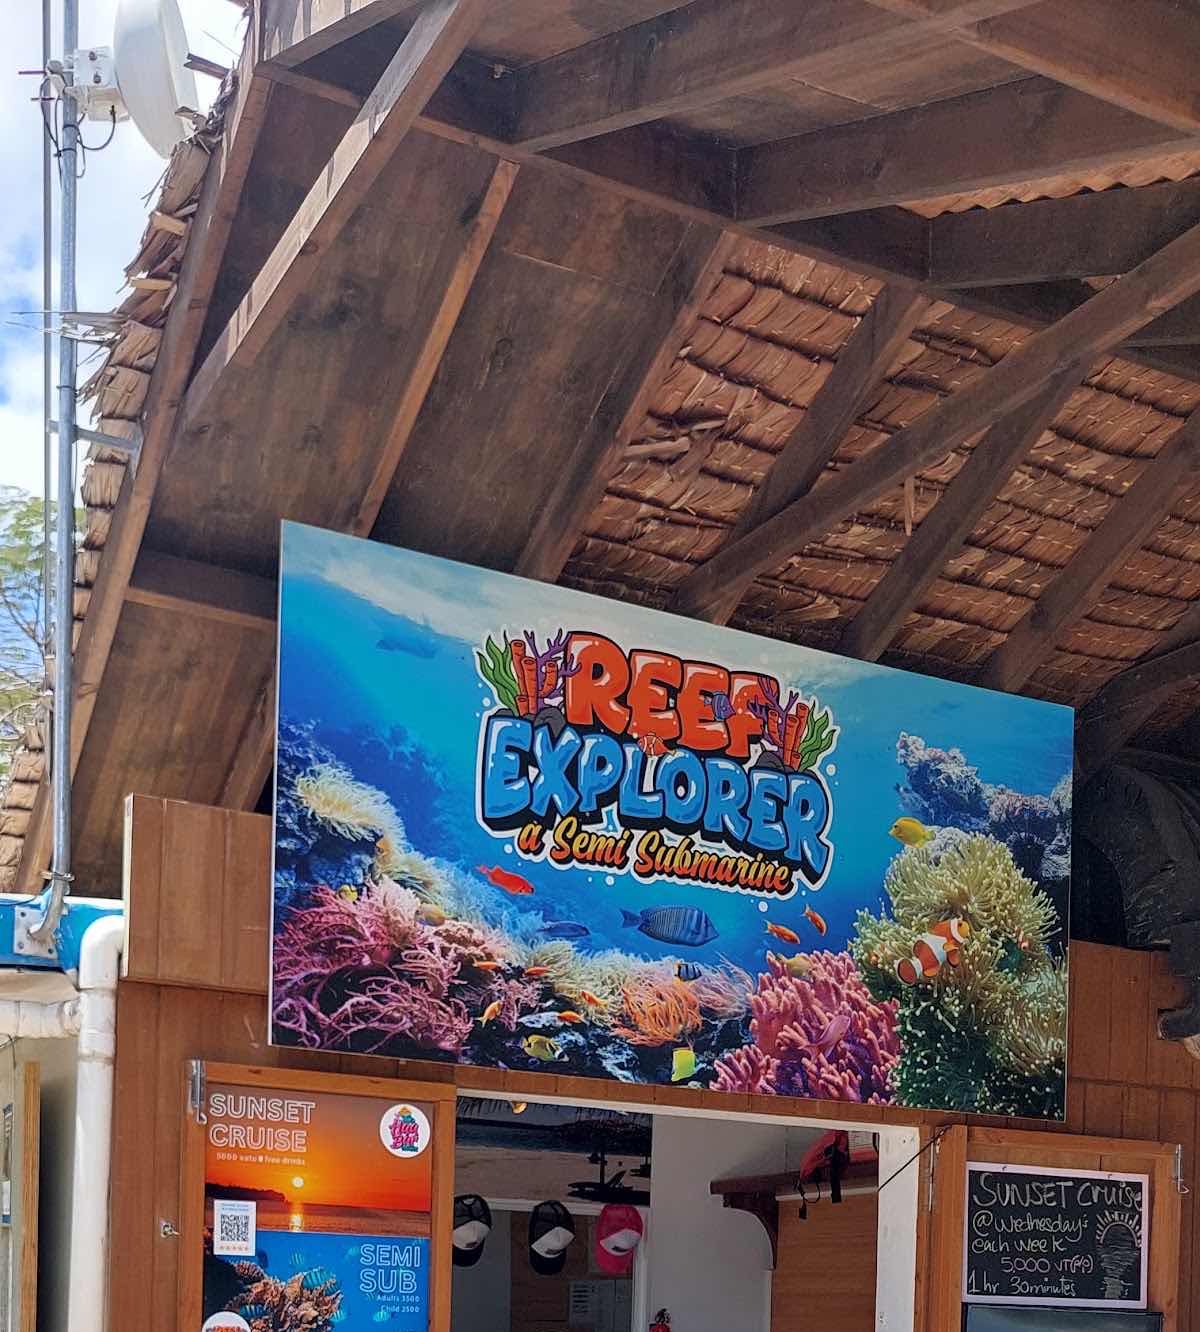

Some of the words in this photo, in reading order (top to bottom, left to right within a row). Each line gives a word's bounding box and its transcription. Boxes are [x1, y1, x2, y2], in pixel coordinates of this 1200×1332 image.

[564, 631, 780, 757] REEF
[482, 715, 831, 880] EXPLORER
[551, 816, 630, 869] Semi
[634, 830, 794, 893] Submarine
[209, 1093, 316, 1124] SUNSET
[209, 1123, 307, 1153] CRUISE
[973, 1172, 1074, 1208] SUNSET
[359, 1243, 421, 1268] SEMI
[972, 1237, 1009, 1254] each
[359, 1268, 417, 1294] SUB
[983, 1271, 1000, 1293] hr
